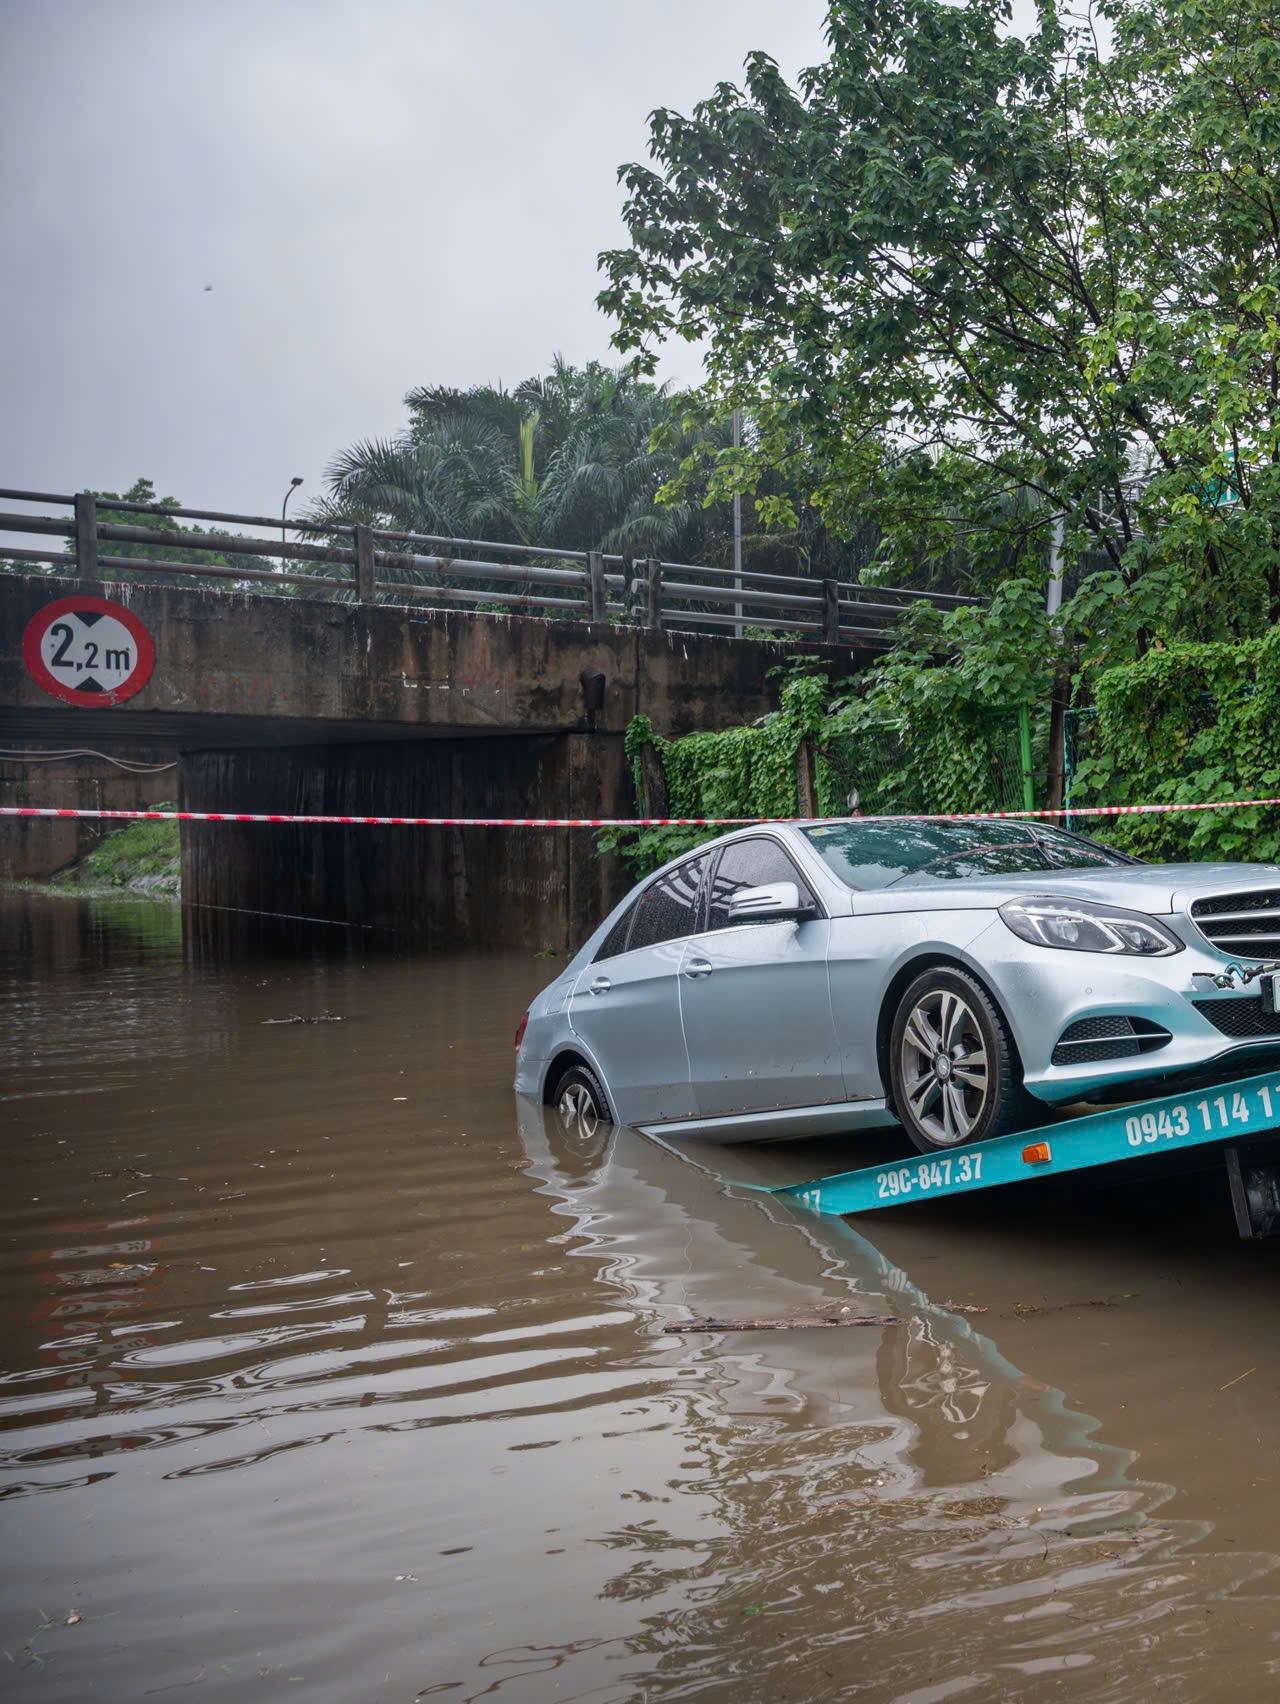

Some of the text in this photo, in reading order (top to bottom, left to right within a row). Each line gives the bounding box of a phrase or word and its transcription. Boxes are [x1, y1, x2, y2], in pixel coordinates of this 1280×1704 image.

[1125, 1105, 1190, 1146] 0943
[1197, 1092, 1250, 1131] 114
[876, 1152, 983, 1199] 29C-847.37
